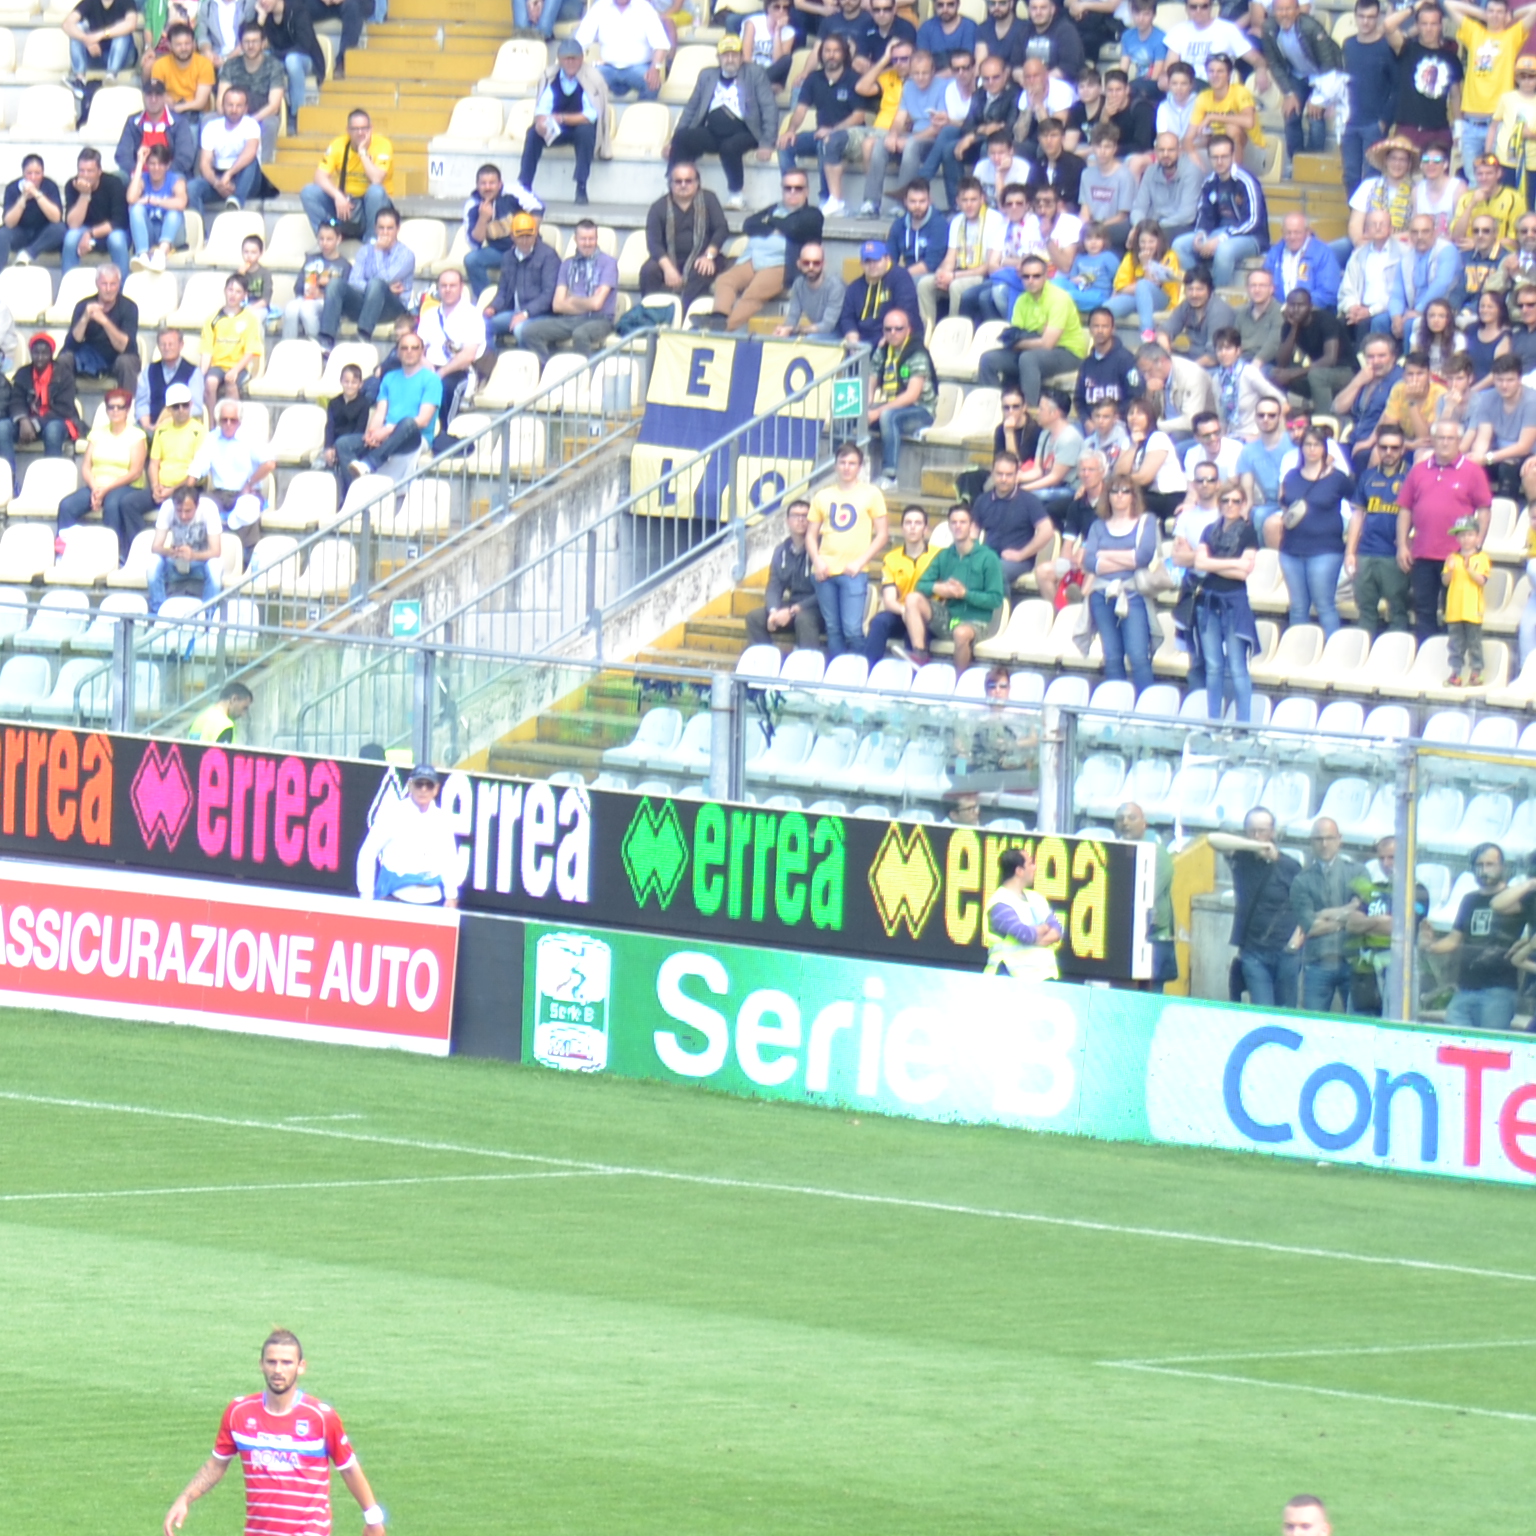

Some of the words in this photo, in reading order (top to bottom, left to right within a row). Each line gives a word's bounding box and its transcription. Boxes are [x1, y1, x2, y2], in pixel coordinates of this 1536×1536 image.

[431, 161, 443, 176] M
[686, 347, 715, 397] E
[783, 357, 815, 402] O
[319, 939, 441, 1014] AUTO
[652, 950, 954, 1106] Serie
[990, 990, 1076, 1117] B
